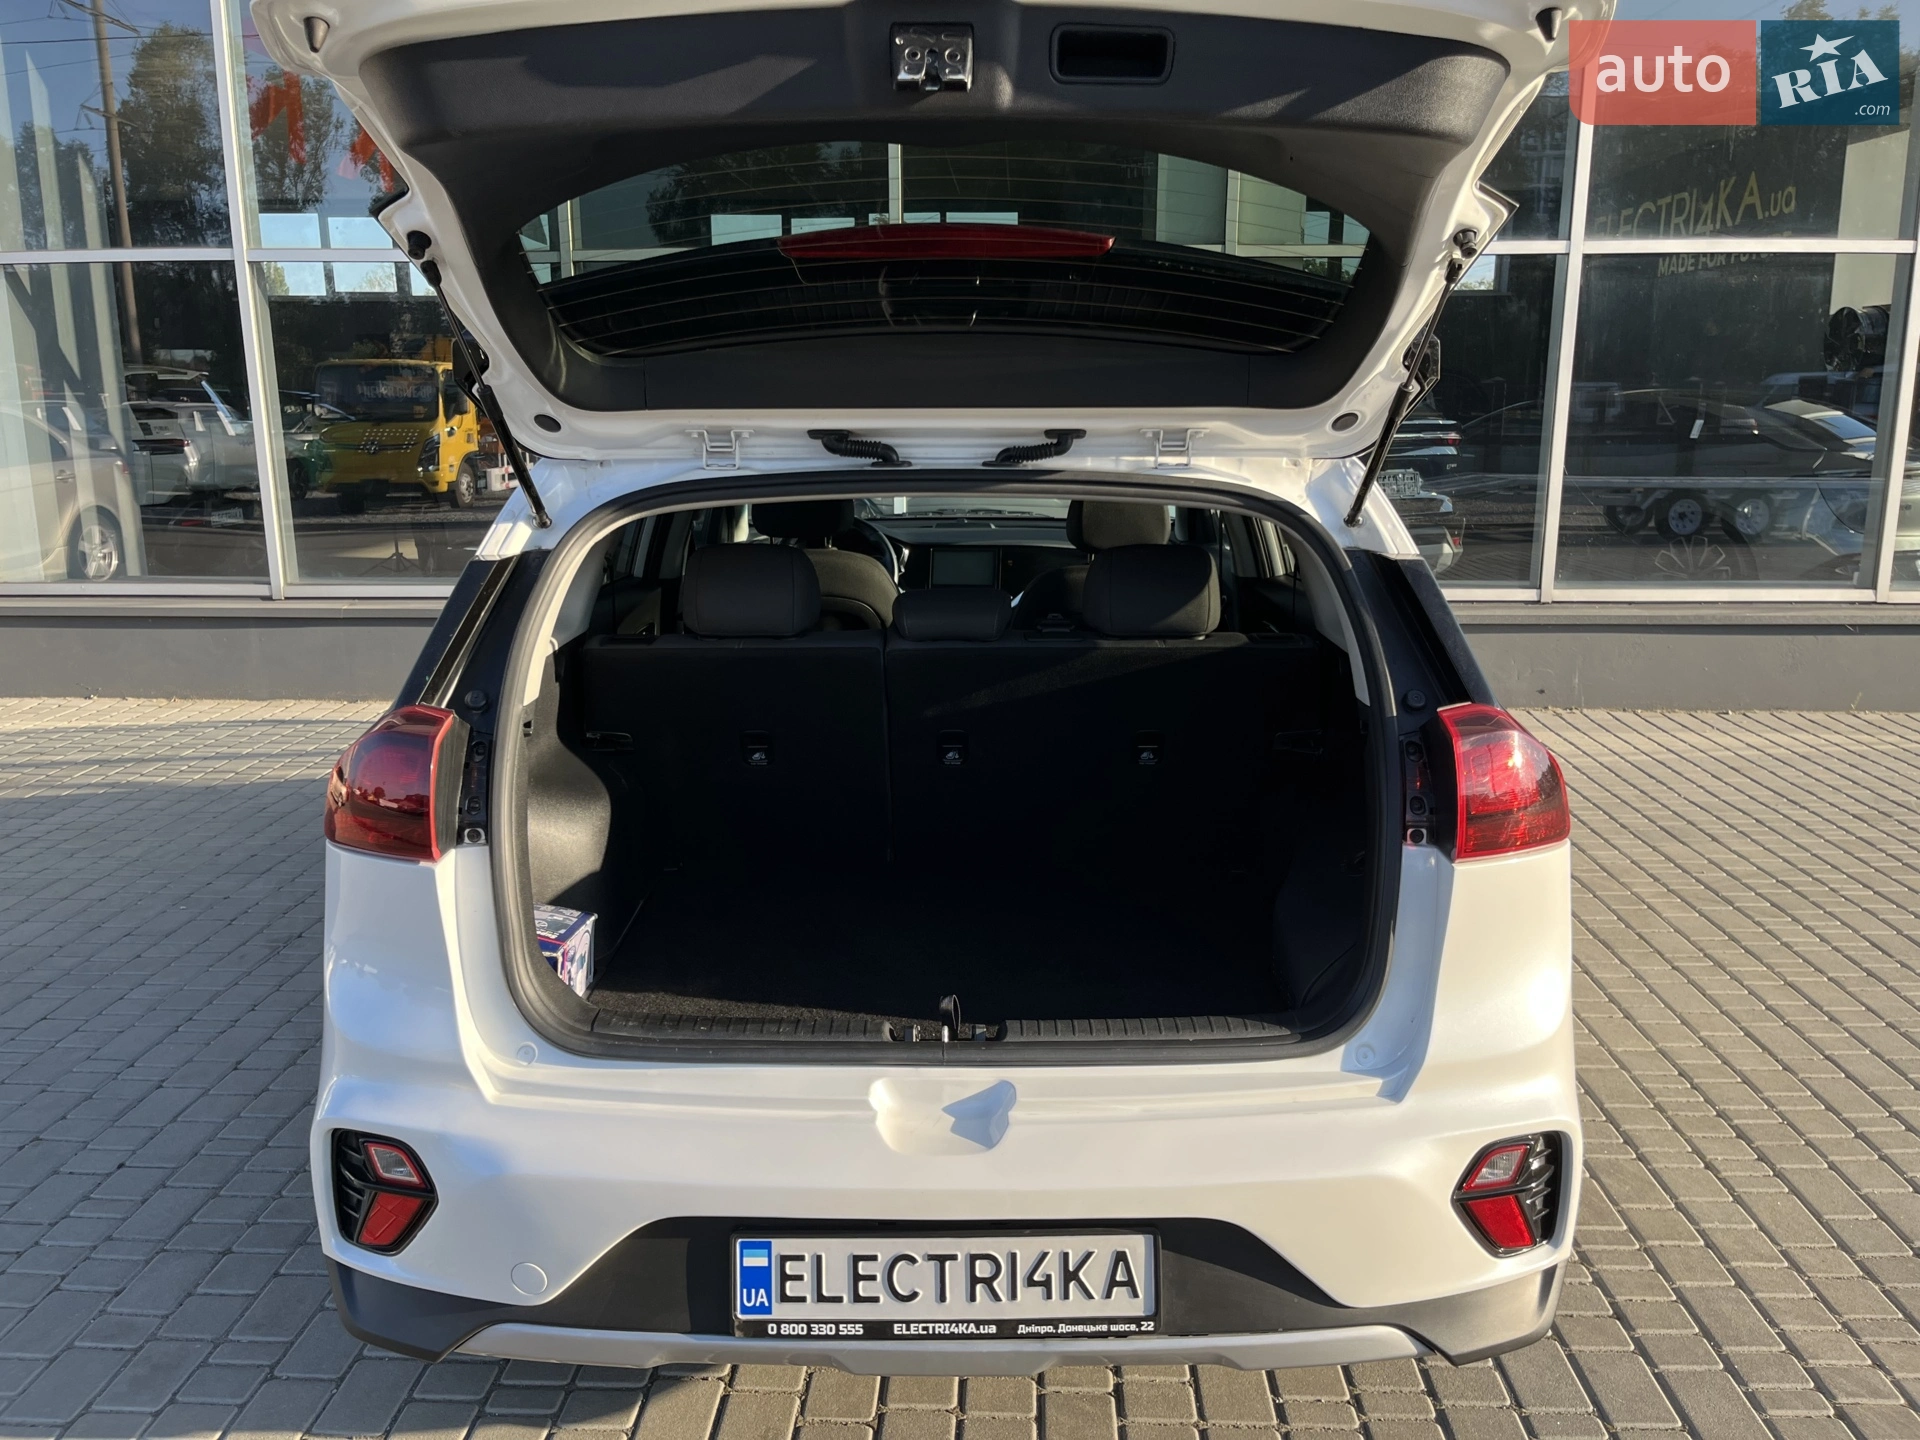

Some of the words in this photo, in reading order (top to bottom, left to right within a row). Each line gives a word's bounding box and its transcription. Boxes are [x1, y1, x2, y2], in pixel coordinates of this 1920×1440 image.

[1657, 257, 1695, 277] MADE
[779, 1250, 1142, 1304] ELECTRI4KA
[742, 1287, 769, 1307] UA
[767, 1323, 777, 1335] 0
[780, 1323, 808, 1335] 800
[810, 1323, 836, 1335] 330
[838, 1323, 864, 1335] 555
[893, 1322, 997, 1335] ELECTRI4KA.ua
[1017, 1323, 1056, 1335] Дніпро,
[1057, 1322, 1108, 1334] Донецьке
[1110, 1322, 1139, 1333] шосе,
[1140, 1321, 1155, 1331] 22
